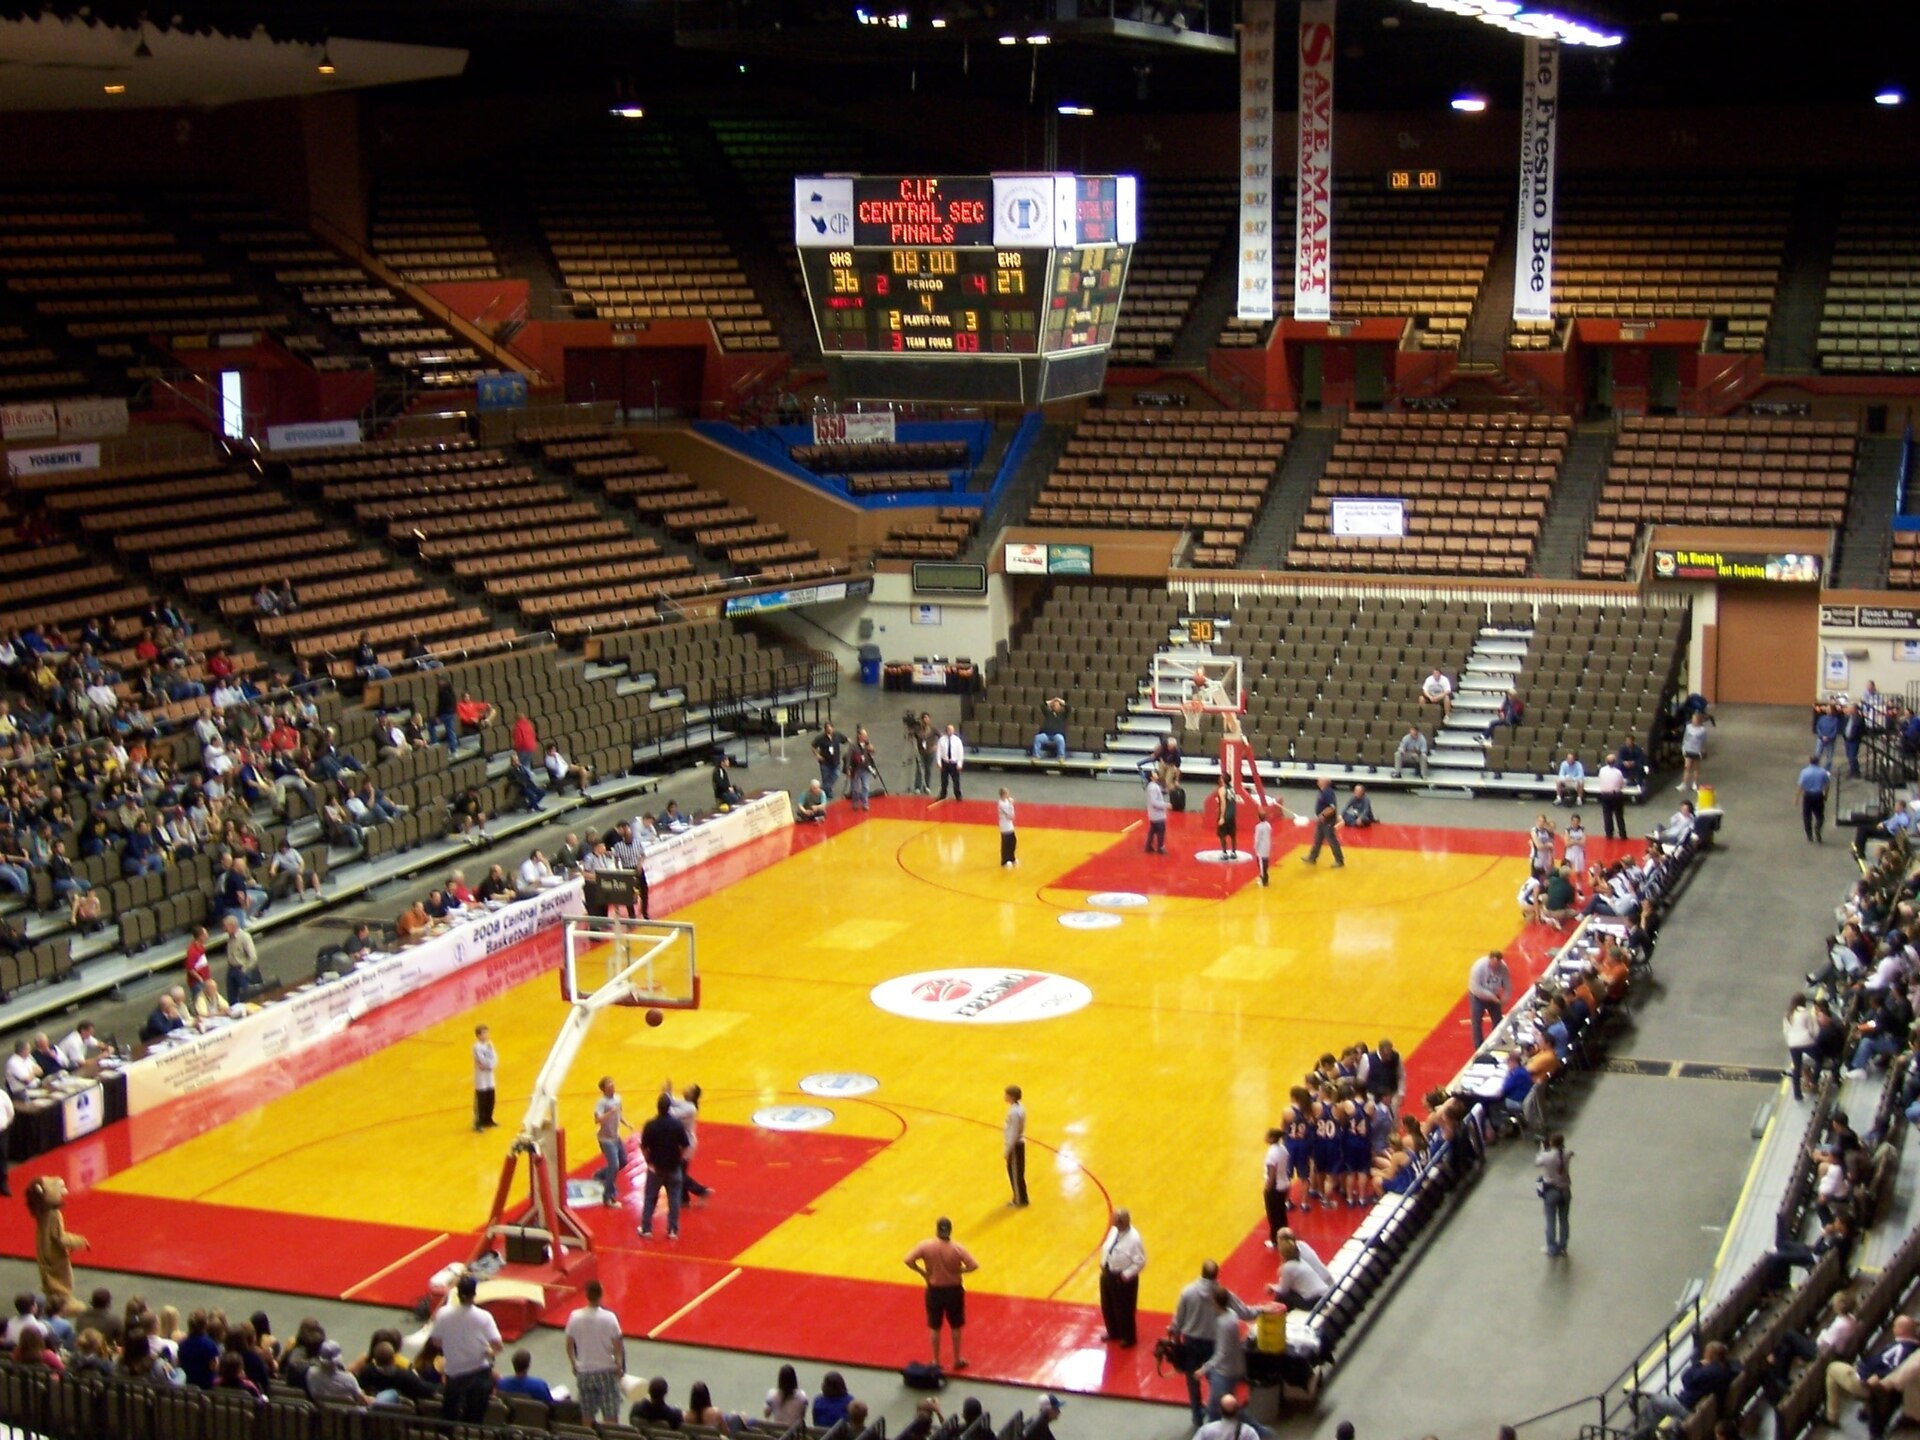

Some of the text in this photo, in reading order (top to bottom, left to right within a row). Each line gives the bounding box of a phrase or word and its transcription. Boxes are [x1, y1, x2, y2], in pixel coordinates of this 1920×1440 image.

[1302, 22, 1332, 153] SAVE
[1533, 96, 1556, 218] Fresno
[900, 179, 942, 200] C.I.F.
[830, 213, 850, 233] CIF
[858, 202, 985, 224] CENTRAL SEC
[891, 224, 954, 244] FINALS
[1312, 165, 1329, 294] MART
[893, 251, 957, 275] 08:00
[1531, 228, 1551, 292] Bee
[833, 269, 860, 293] 36
[877, 275, 890, 296] 2
[906, 279, 944, 292] PERIOD
[975, 275, 988, 295] 4
[997, 270, 1025, 294] 27
[920, 294, 933, 312] 4
[889, 311, 900, 331] 2
[965, 311, 977, 331] 3
[905, 336, 952, 349] TEAM FOULS
[29, 451, 82, 467] YOSEMITE
[1861, 609, 1888, 618] Snack
[1892, 609, 1914, 619] Bars
[1861, 617, 1910, 627] Restrooms
[1190, 621, 1212, 640] 30
[473, 890, 574, 943] 2008 Central Section
[486, 922, 534, 954] Basketball
[1316, 1119, 1336, 1139] 20
